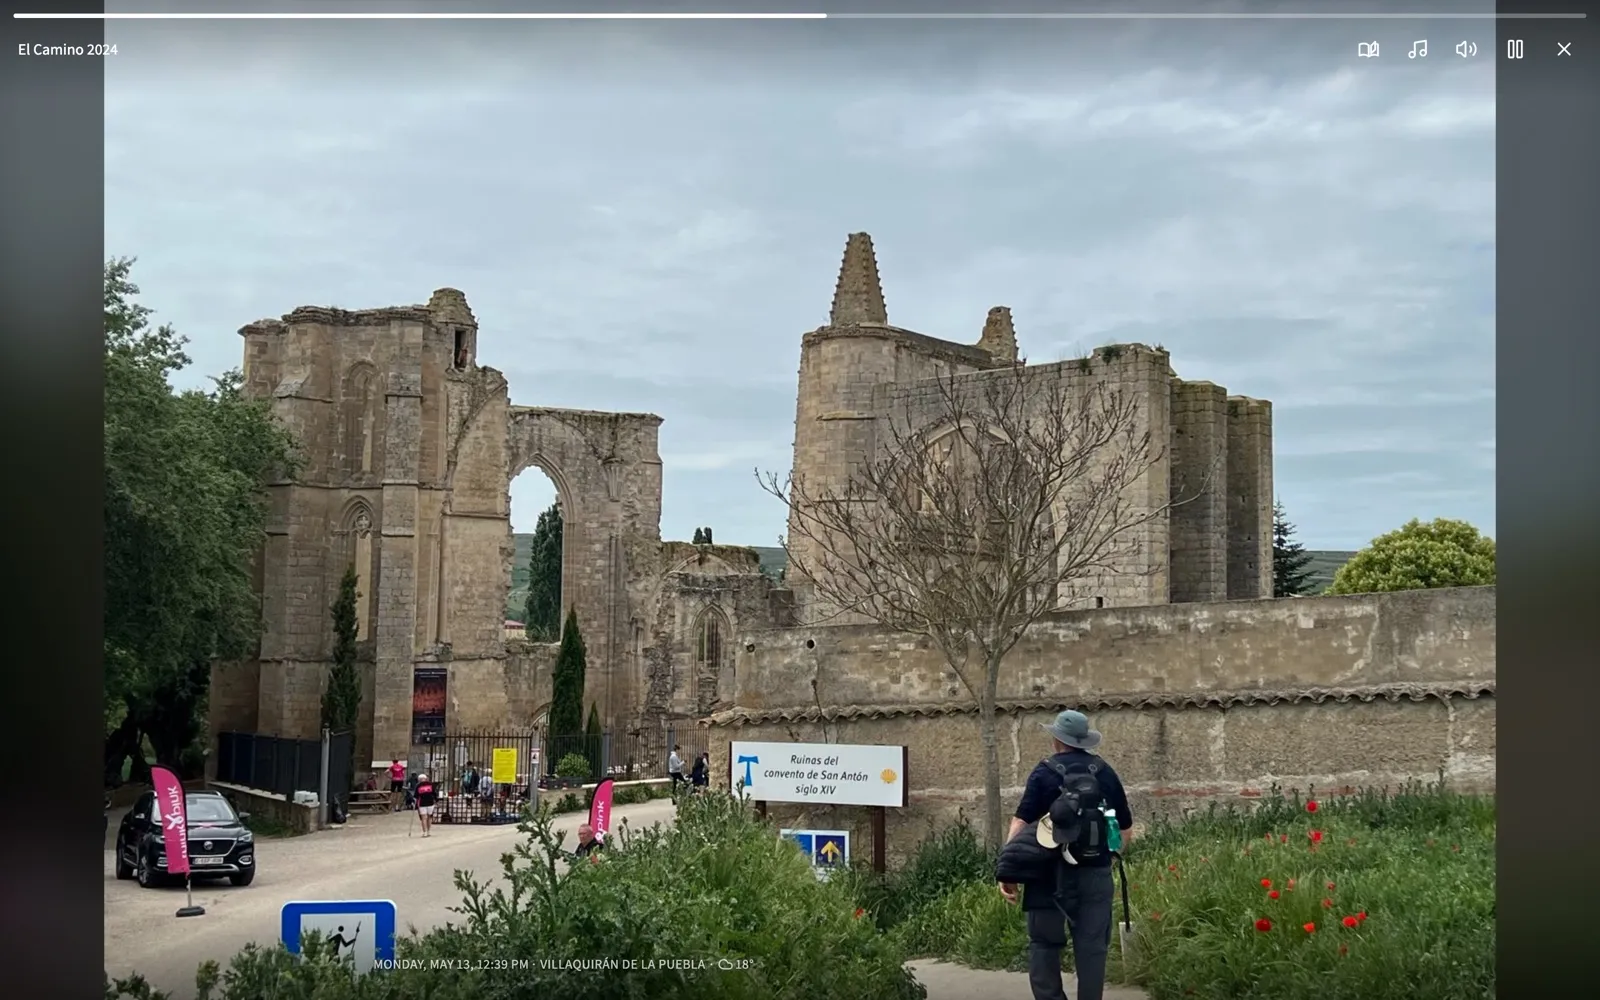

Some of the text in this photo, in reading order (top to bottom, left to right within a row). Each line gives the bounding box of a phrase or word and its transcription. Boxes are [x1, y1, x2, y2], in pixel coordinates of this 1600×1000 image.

[790, 755, 839, 766] Ruinas del
[763, 768, 868, 782] convento de San Antón
[795, 784, 837, 796] siglo XIV
[597, 800, 605, 831] pink
